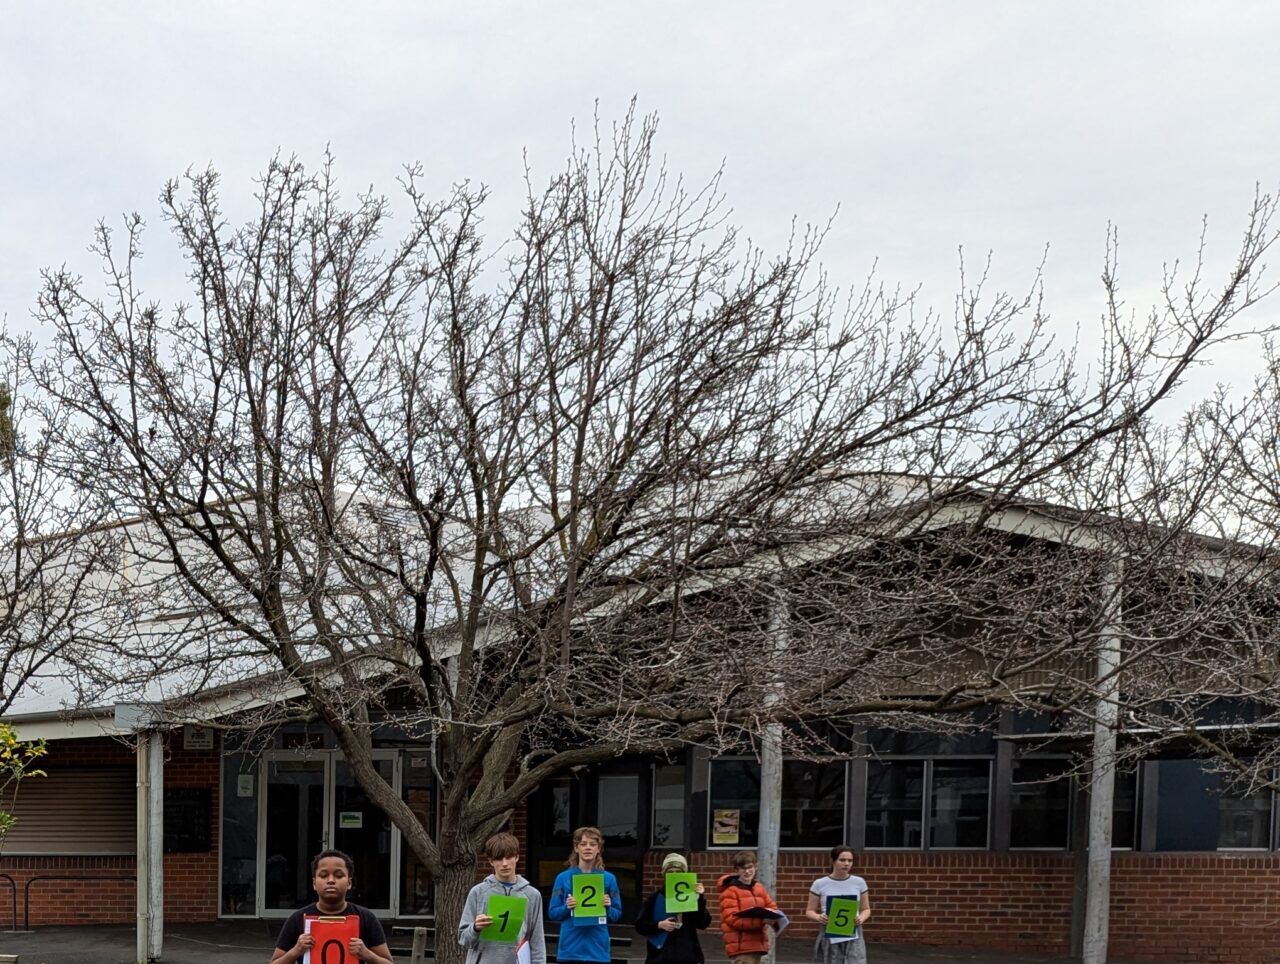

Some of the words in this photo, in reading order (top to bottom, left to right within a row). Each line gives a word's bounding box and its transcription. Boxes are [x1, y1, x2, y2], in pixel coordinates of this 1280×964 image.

[580, 885, 597, 907] 2
[498, 910, 510, 933] 1
[834, 908, 850, 927] 5
